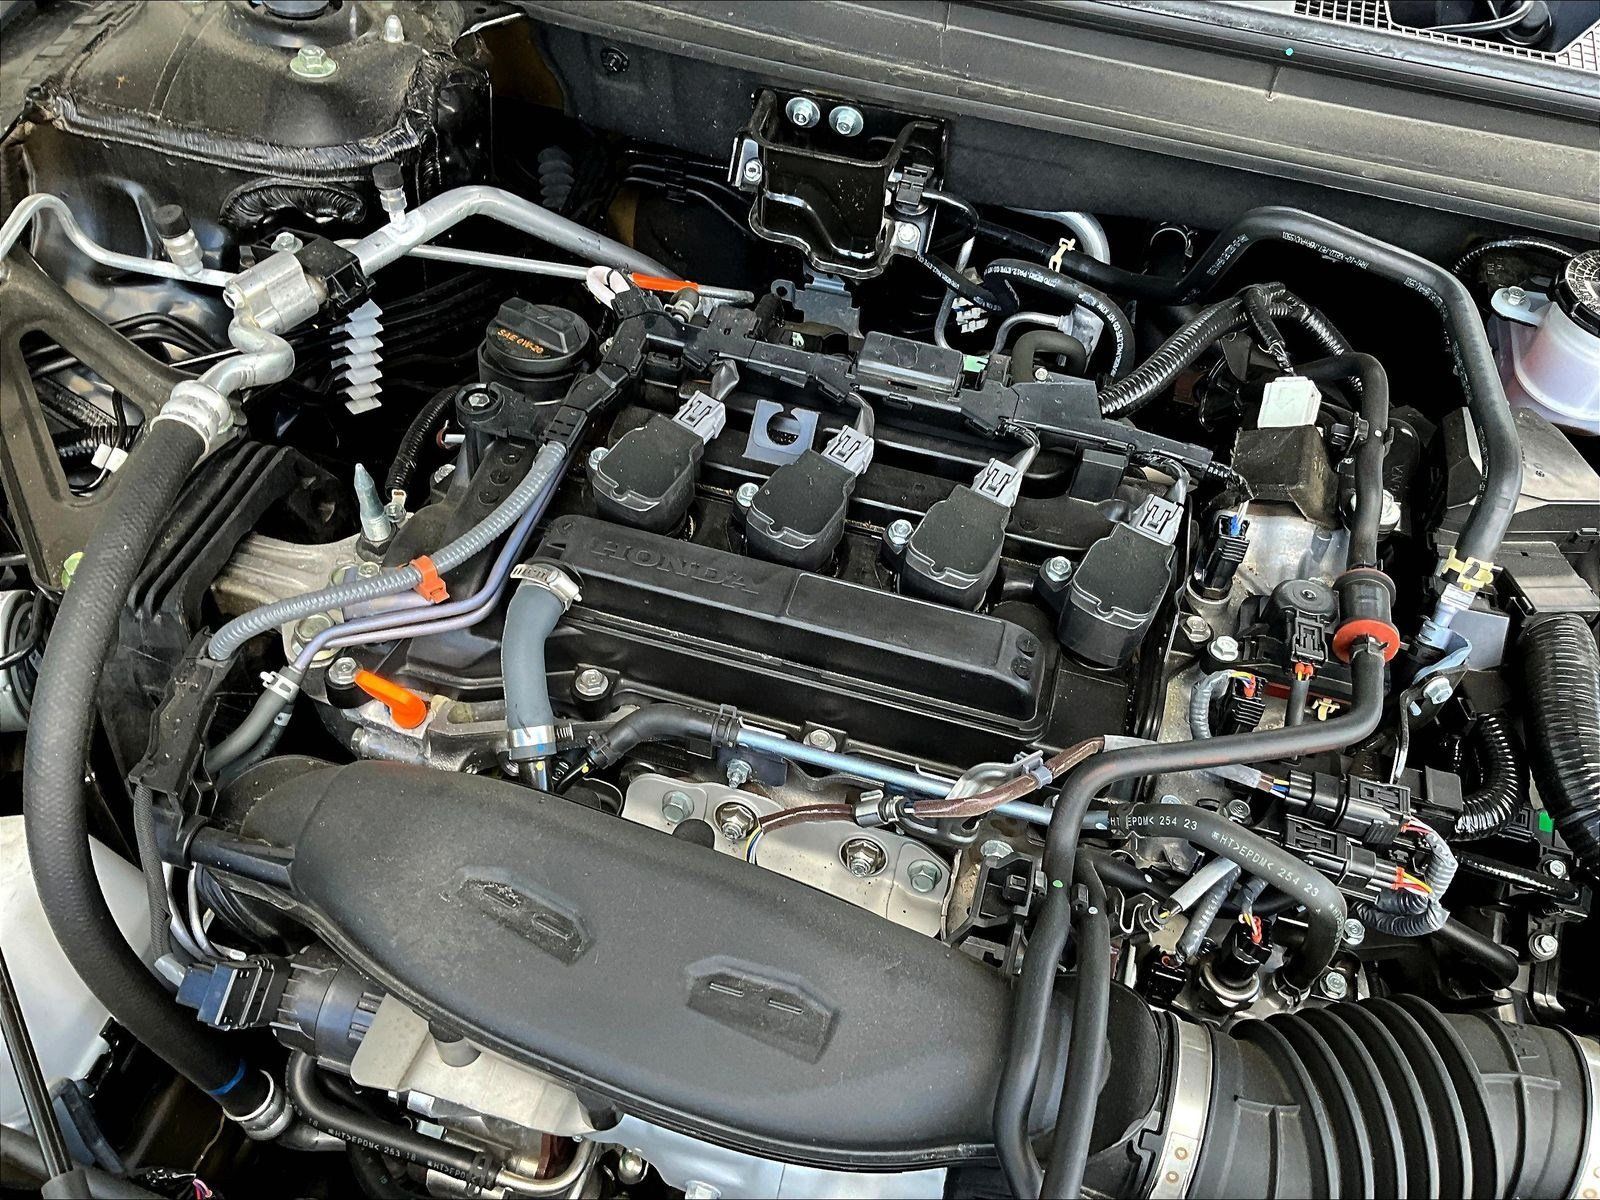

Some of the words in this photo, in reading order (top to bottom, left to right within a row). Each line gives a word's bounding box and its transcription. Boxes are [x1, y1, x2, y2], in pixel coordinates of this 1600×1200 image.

[497, 328, 518, 342] SAE
[591, 540, 760, 596] HONDA
[1159, 815, 1177, 827] 254
[1183, 818, 1198, 831] 23
[1277, 867, 1300, 886] 254
[1303, 882, 1320, 898] 23
